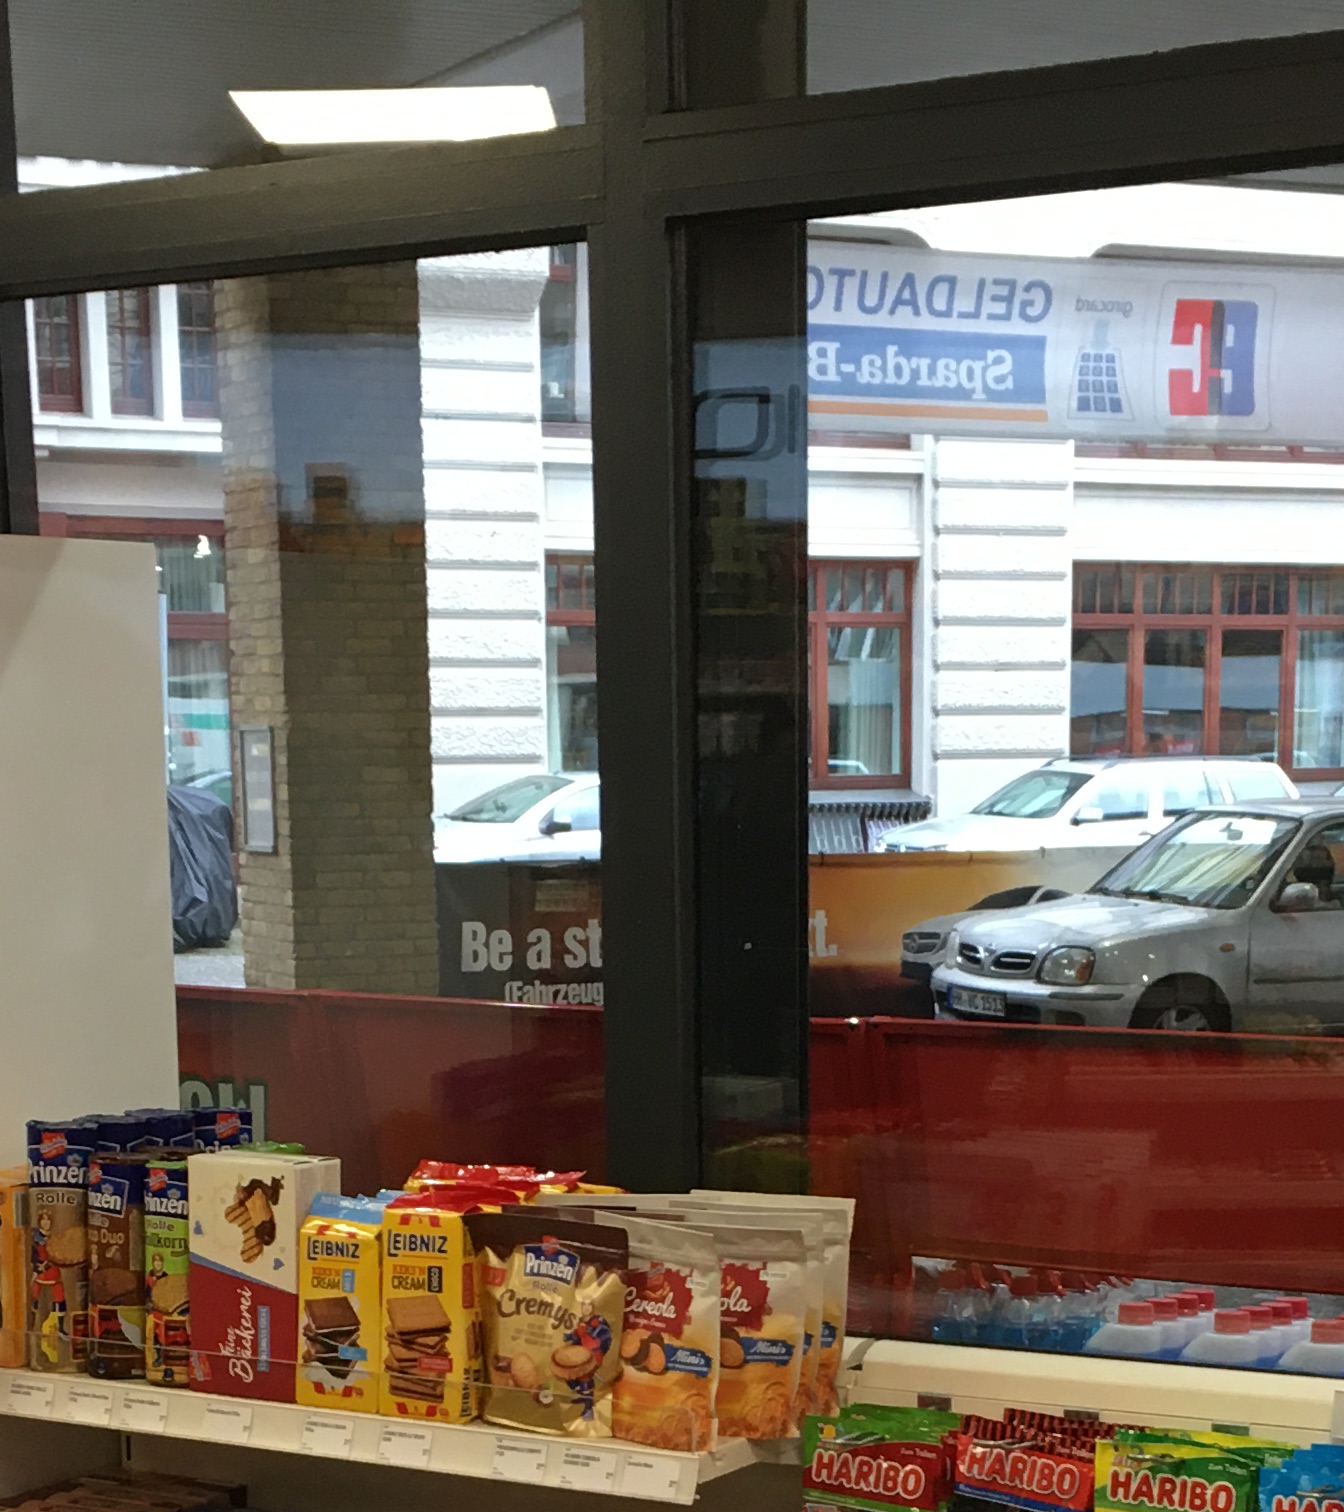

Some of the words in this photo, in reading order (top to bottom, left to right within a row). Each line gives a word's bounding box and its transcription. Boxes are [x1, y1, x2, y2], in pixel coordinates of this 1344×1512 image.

[461, 921, 513, 973] Be
[526, 928, 551, 969] a
[35, 1191, 77, 1206] Rolle
[307, 1235, 360, 1261] LEIBNIZ
[387, 1229, 448, 1258] LEIBNIZ
[524, 1250, 575, 1281] Prinzen
[311, 1276, 341, 1291] CREAM
[391, 1275, 426, 1291] CREAM
[496, 1289, 578, 1330] Cremys
[812, 1449, 925, 1499] HARIBO
[964, 1447, 1080, 1498] HARIBO
